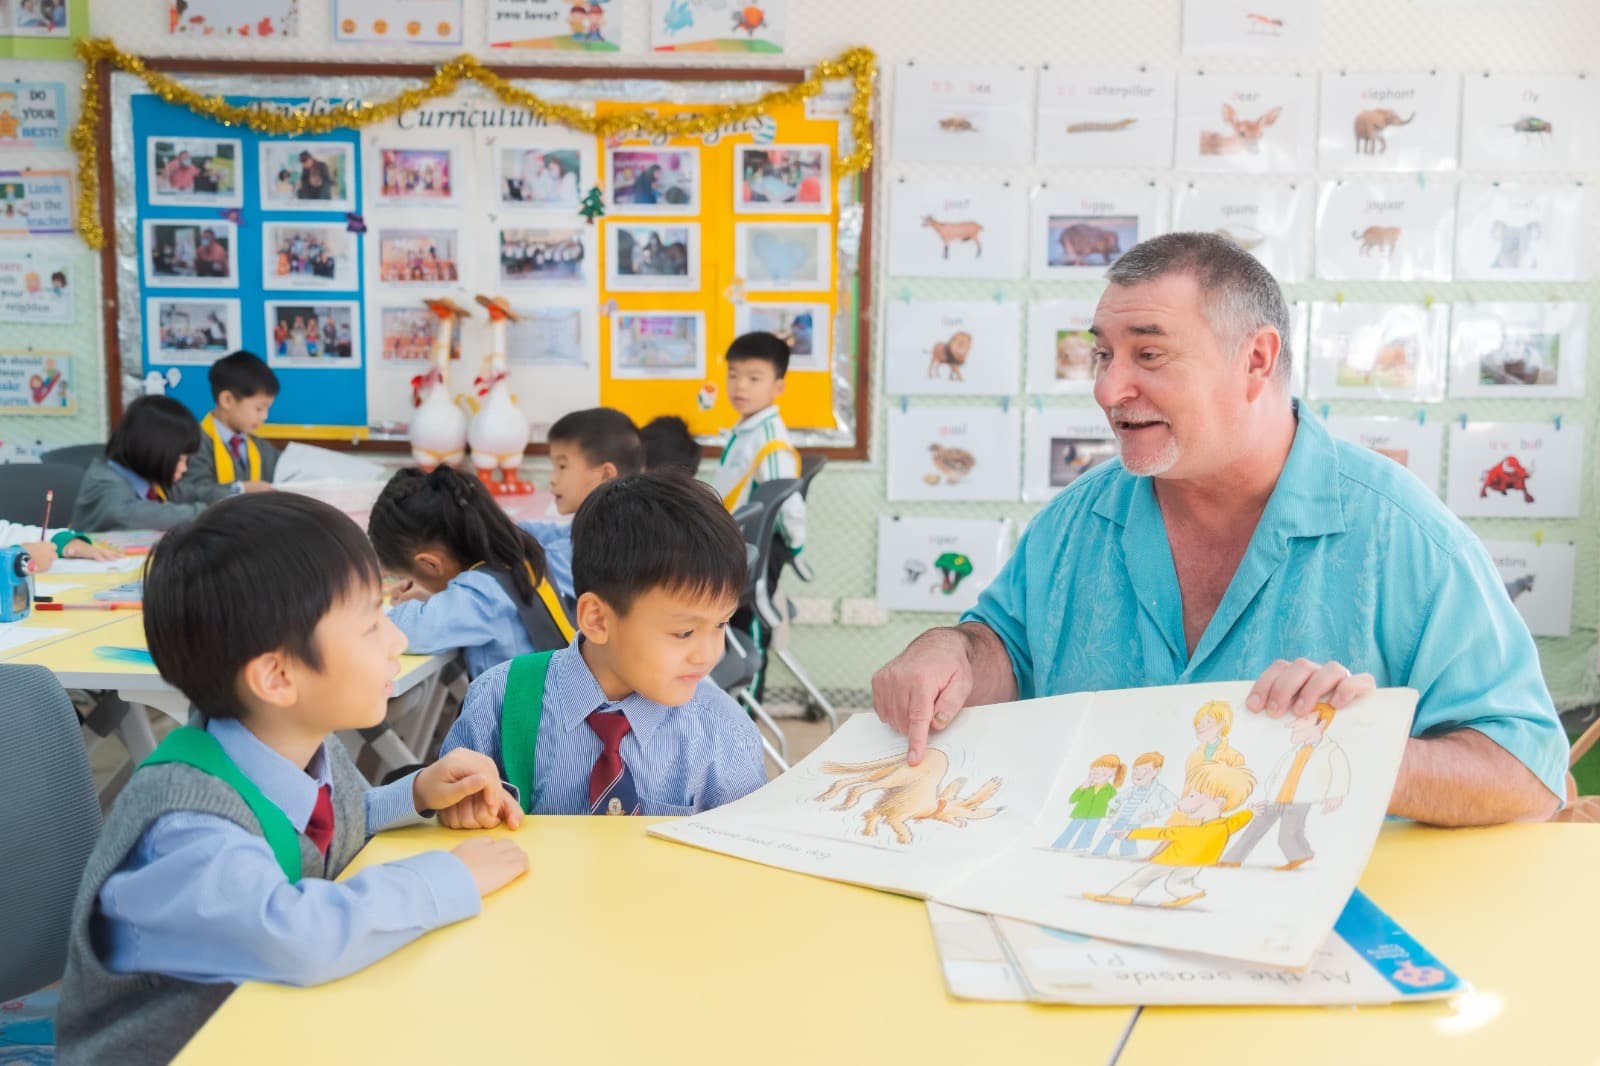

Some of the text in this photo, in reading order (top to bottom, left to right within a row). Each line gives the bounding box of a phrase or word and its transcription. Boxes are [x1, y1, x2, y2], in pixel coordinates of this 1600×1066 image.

[496, 11, 521, 21] you
[30, 90, 46, 101] DO
[1361, 87, 1416, 102] elephant
[22, 107, 56, 120] YOUR
[397, 101, 549, 130] Curriculum
[22, 127, 58, 137] BEST!
[1112, 968, 1233, 985] seaside
